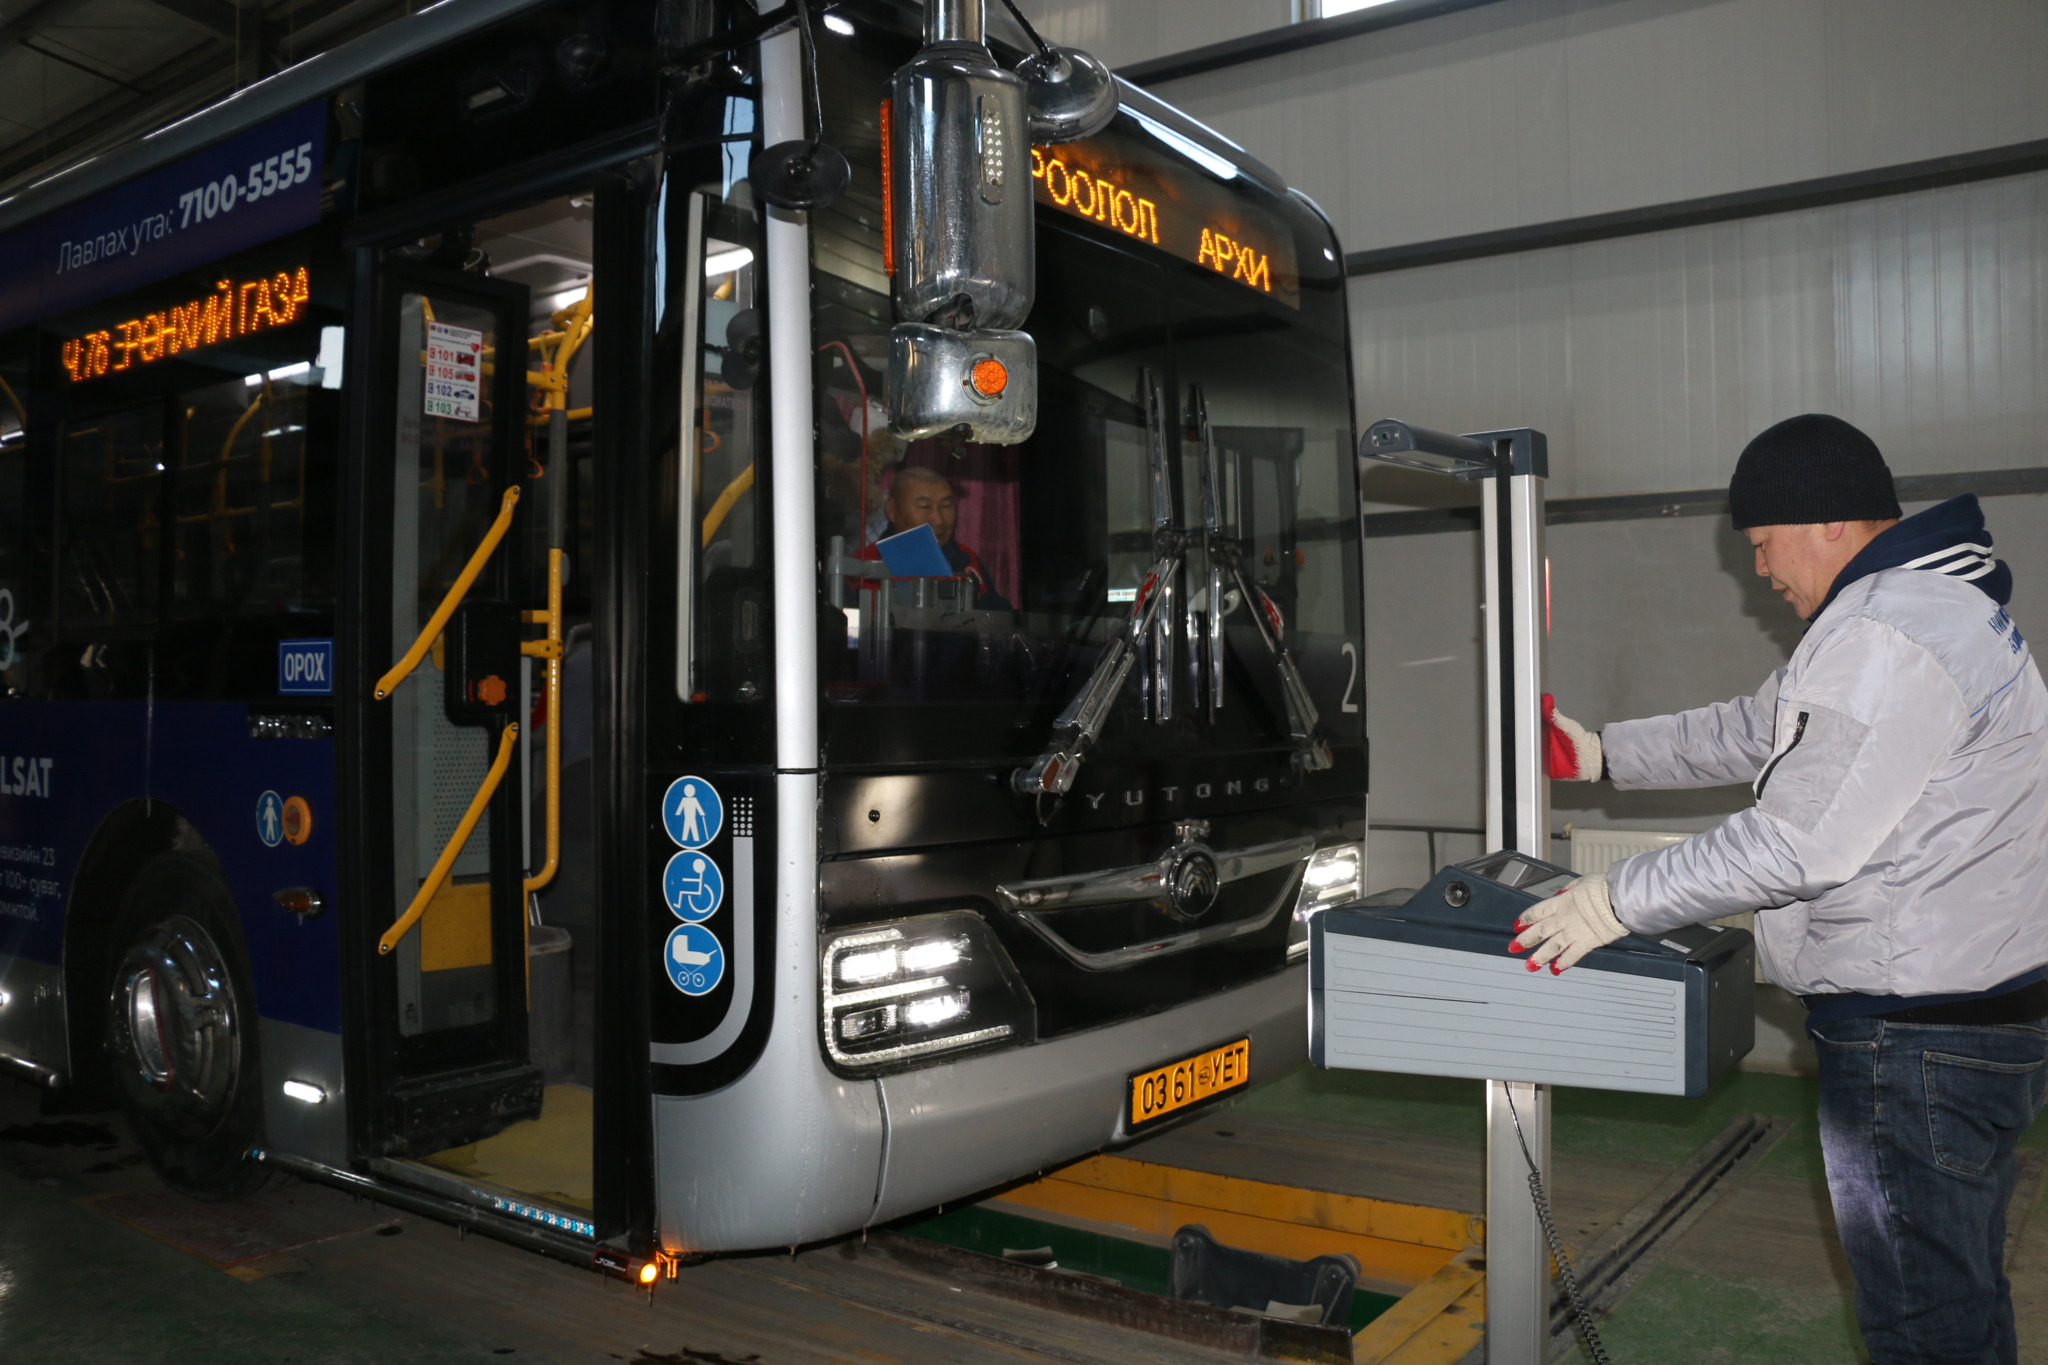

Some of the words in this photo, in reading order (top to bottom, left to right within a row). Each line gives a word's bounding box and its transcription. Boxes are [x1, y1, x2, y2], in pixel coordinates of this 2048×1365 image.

[57, 225, 128, 275] Лавлах
[179, 142, 312, 229] 7100-5555
[1199, 228, 1271, 292] АРХИ
[438, 349, 454, 362] 101
[437, 366, 454, 380] 105
[436, 384, 453, 397] 102
[435, 403, 452, 416] 103
[284, 652, 326, 682] ОРОХ
[1341, 642, 1359, 713] 2
[1086, 778, 1270, 810] YUTONG
[1210, 1047, 1245, 1087] УЕТ
